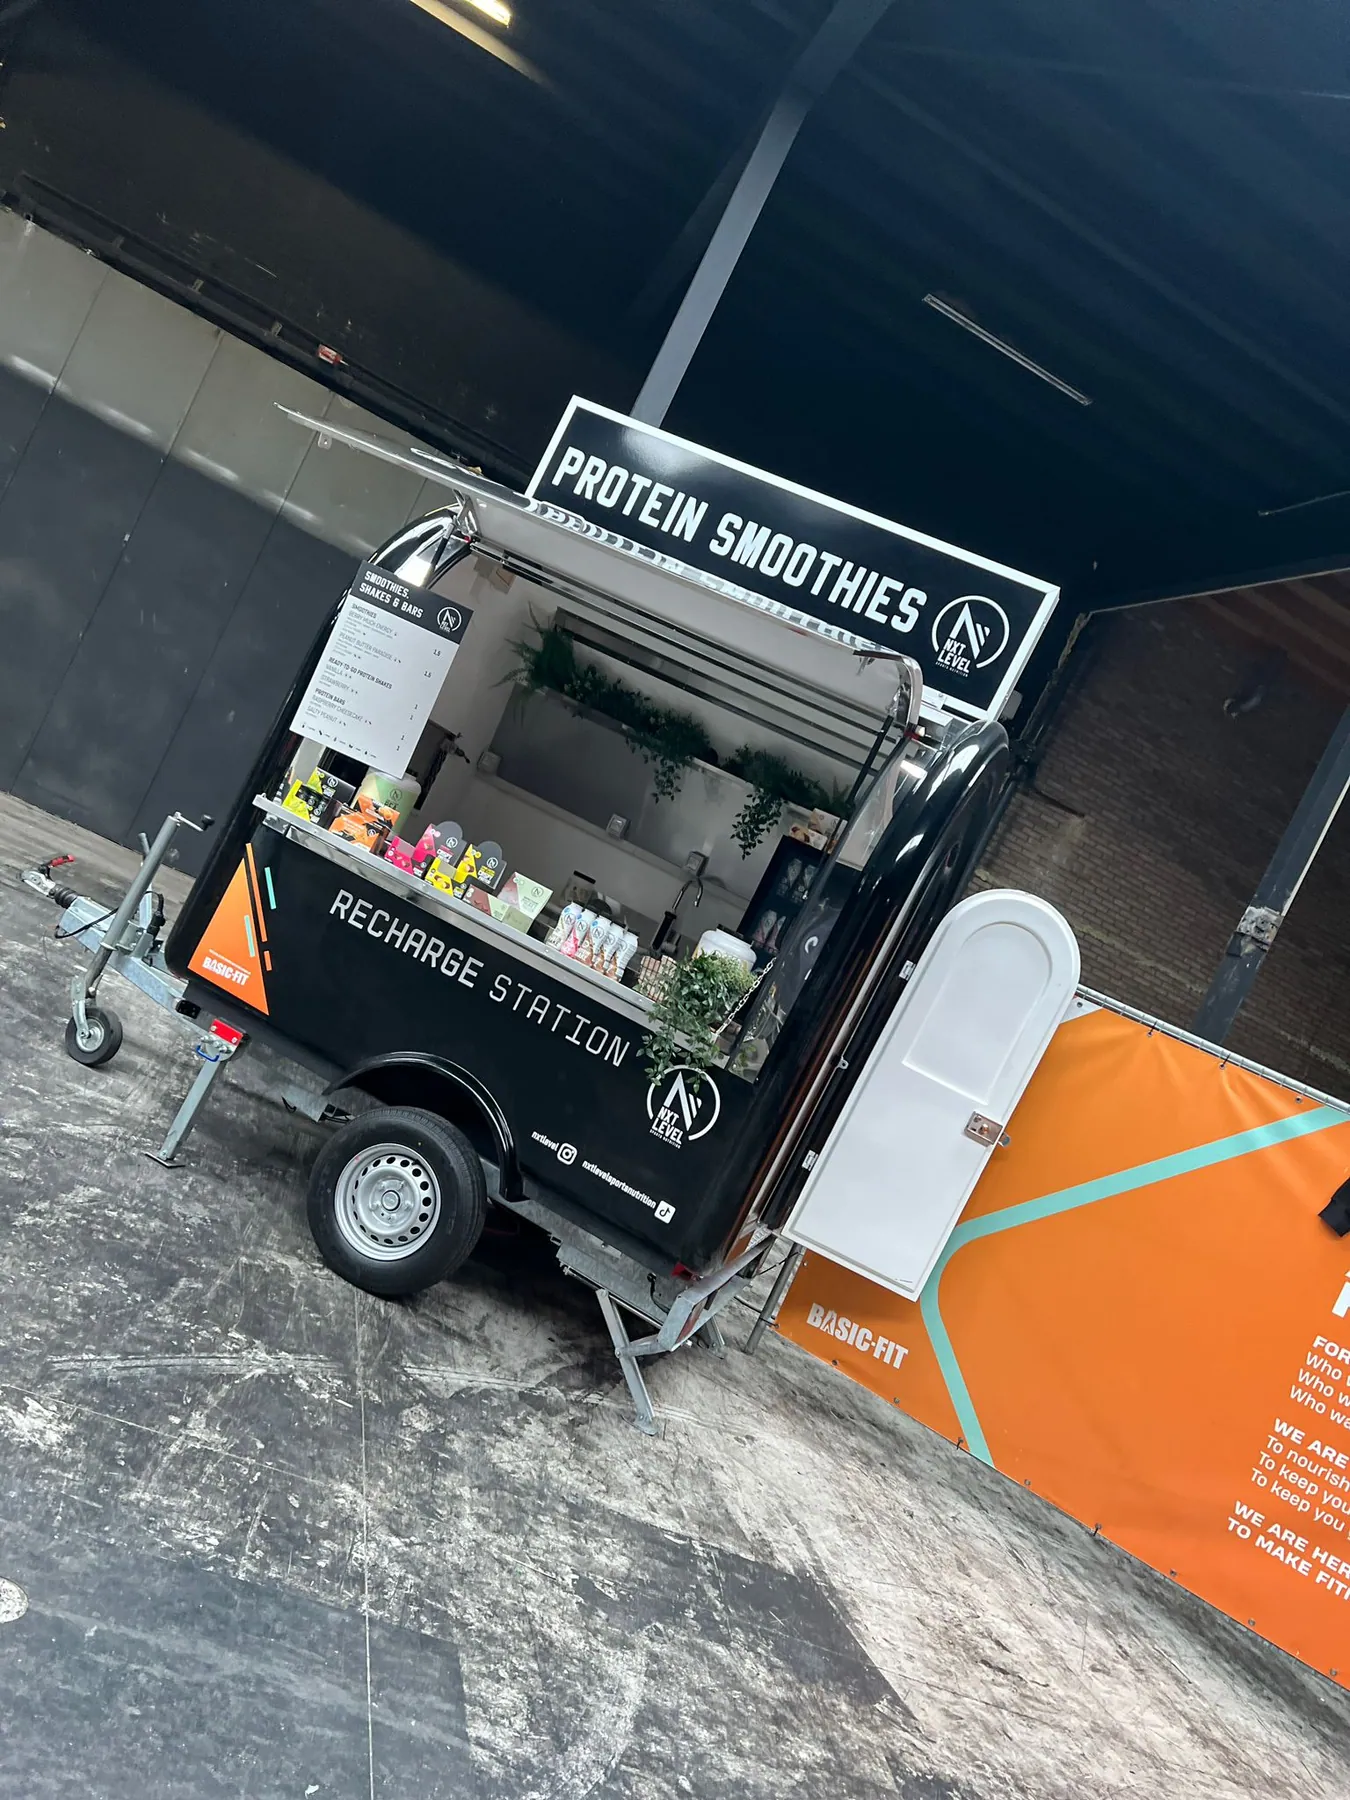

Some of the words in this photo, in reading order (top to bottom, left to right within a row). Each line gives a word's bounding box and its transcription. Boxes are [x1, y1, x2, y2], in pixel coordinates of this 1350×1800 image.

[551, 446, 709, 543] PROTEIN
[709, 512, 928, 634] SMOOTHIES
[352, 604, 377, 618] SMOOTHIES
[359, 583, 391, 603] SHAKES
[393, 598, 400, 607] &
[401, 602, 423, 618] BARS
[339, 632, 356, 643] PEANUT
[356, 640, 372, 651] BUTTER
[943, 638, 966, 656] NXT
[938, 649, 970, 673] LEVEL
[357, 670, 375, 681] PROTEIN
[375, 678, 392, 689] SHAKES
[315, 688, 333, 700] PROTEIN
[333, 696, 345, 705] BARS
[320, 711, 337, 722] PEANUT
[202, 956, 249, 985] BASIC-FIT
[330, 889, 484, 988] RECHARGE
[490, 975, 630, 1066] STATION
[657, 1108, 679, 1124] NXT
[532, 1132, 559, 1151] nxtlevel
[652, 1119, 683, 1144] LEVEL
[582, 1161, 656, 1208] nxtlevelsportsnutrition
[806, 1303, 909, 1370] BASIC-FIT
[1313, 1336, 1350, 1364] FOR
[1307, 1352, 1342, 1380] Who
[1299, 1369, 1334, 1397] Who
[1291, 1385, 1326, 1414] Who
[1275, 1418, 1305, 1444] WE
[1308, 1440, 1349, 1469] ARE
[1267, 1435, 1283, 1454] To
[1287, 1450, 1350, 1492] nourish
[1259, 1451, 1275, 1470] To
[1276, 1464, 1318, 1495] keep
[1322, 1490, 1350, 1515] you
[1252, 1468, 1267, 1487] To
[1270, 1480, 1310, 1512] keep
[1314, 1507, 1345, 1531] you
[1235, 1501, 1265, 1527] WE
[1267, 1524, 1308, 1552] ARE
[1228, 1517, 1251, 1539] TO
[1255, 1535, 1312, 1576] MAKE
